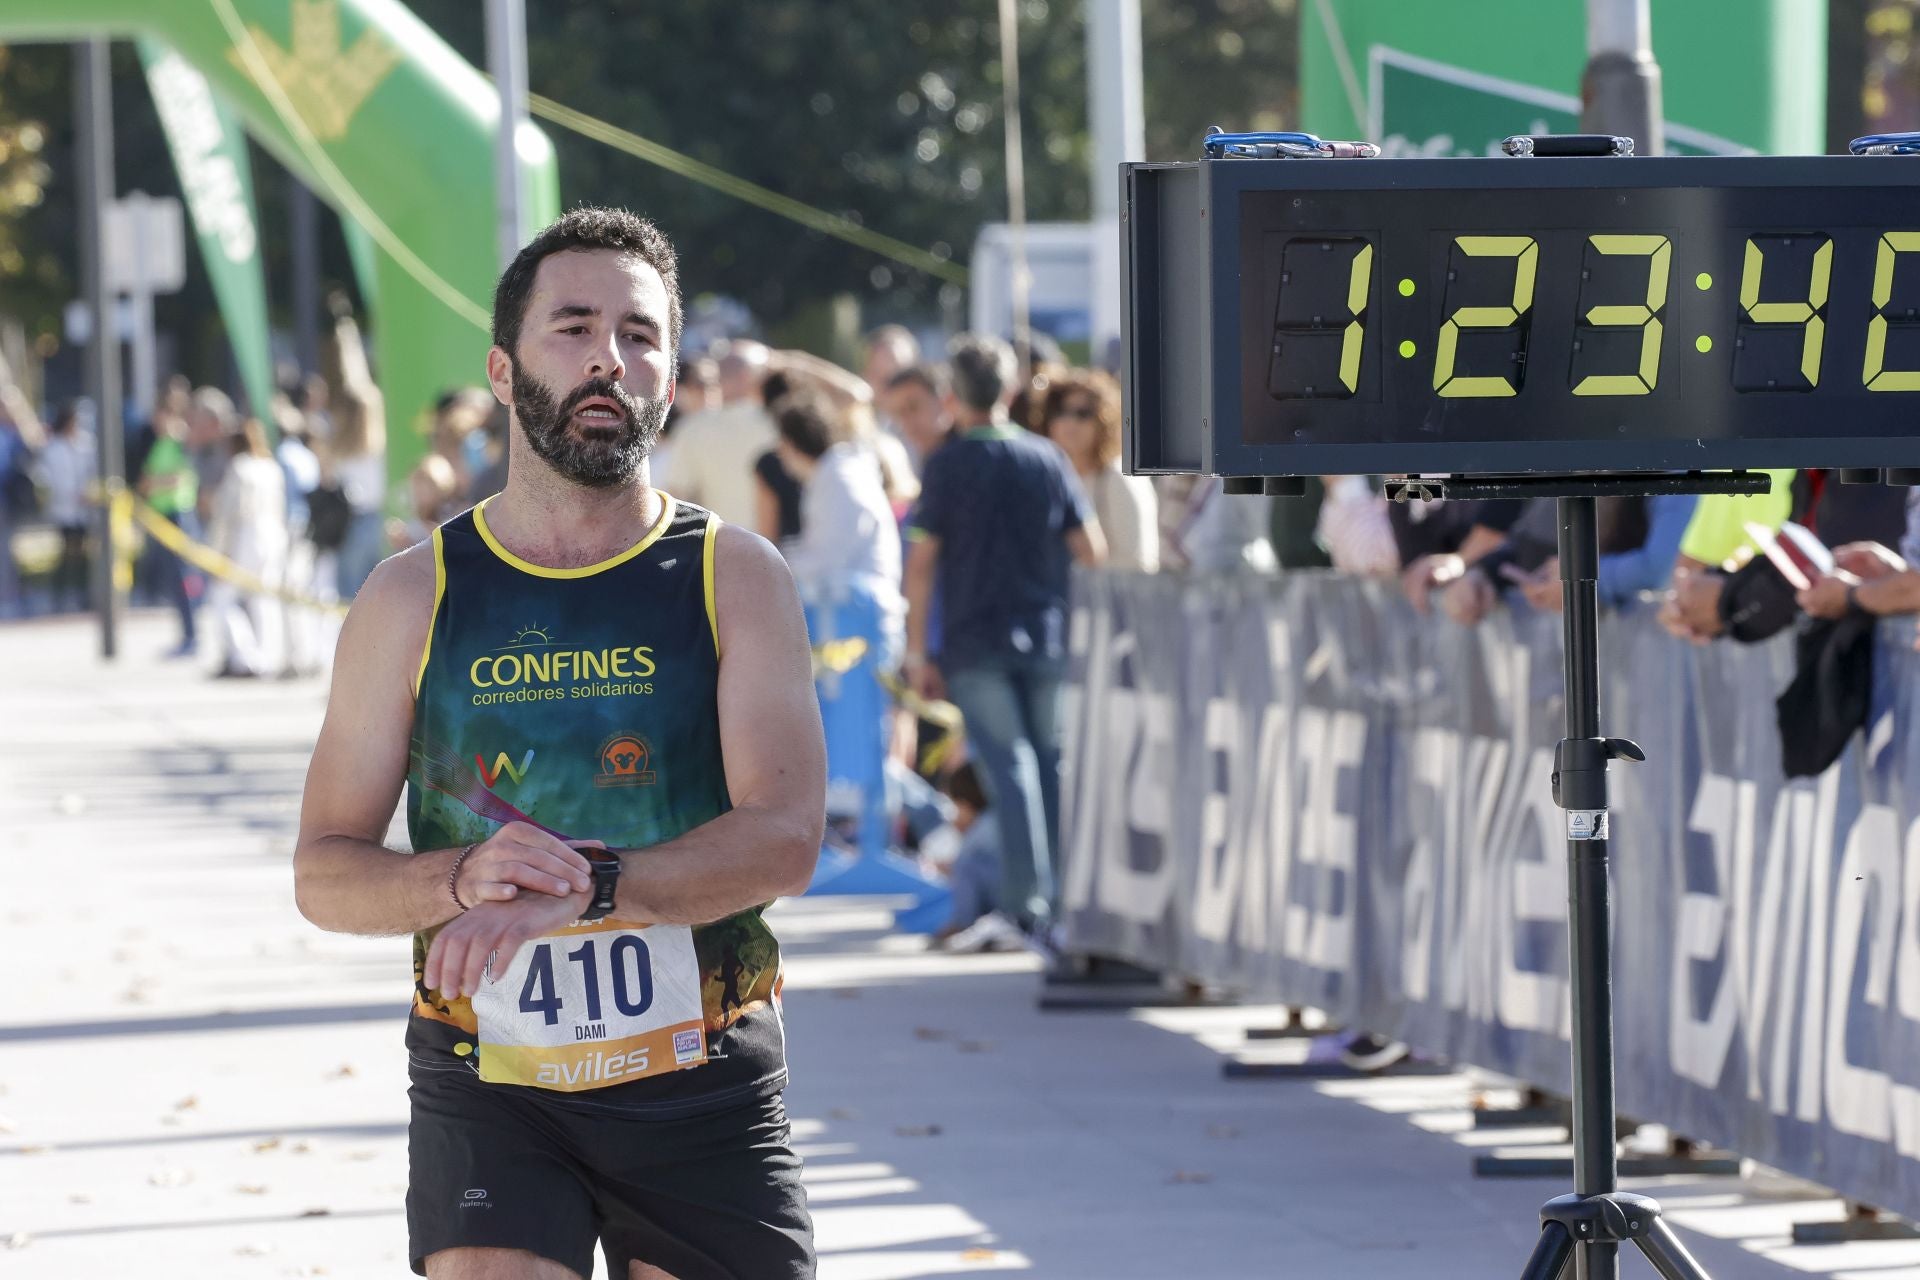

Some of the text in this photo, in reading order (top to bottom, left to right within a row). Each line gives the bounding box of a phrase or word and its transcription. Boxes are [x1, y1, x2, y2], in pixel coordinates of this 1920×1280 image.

[470, 646, 656, 688] CONFINES
[473, 680, 653, 706] corredores solidarios
[518, 934, 654, 1026] 410
[575, 1023, 606, 1041] DAMI
[536, 1047, 650, 1085] avilés
